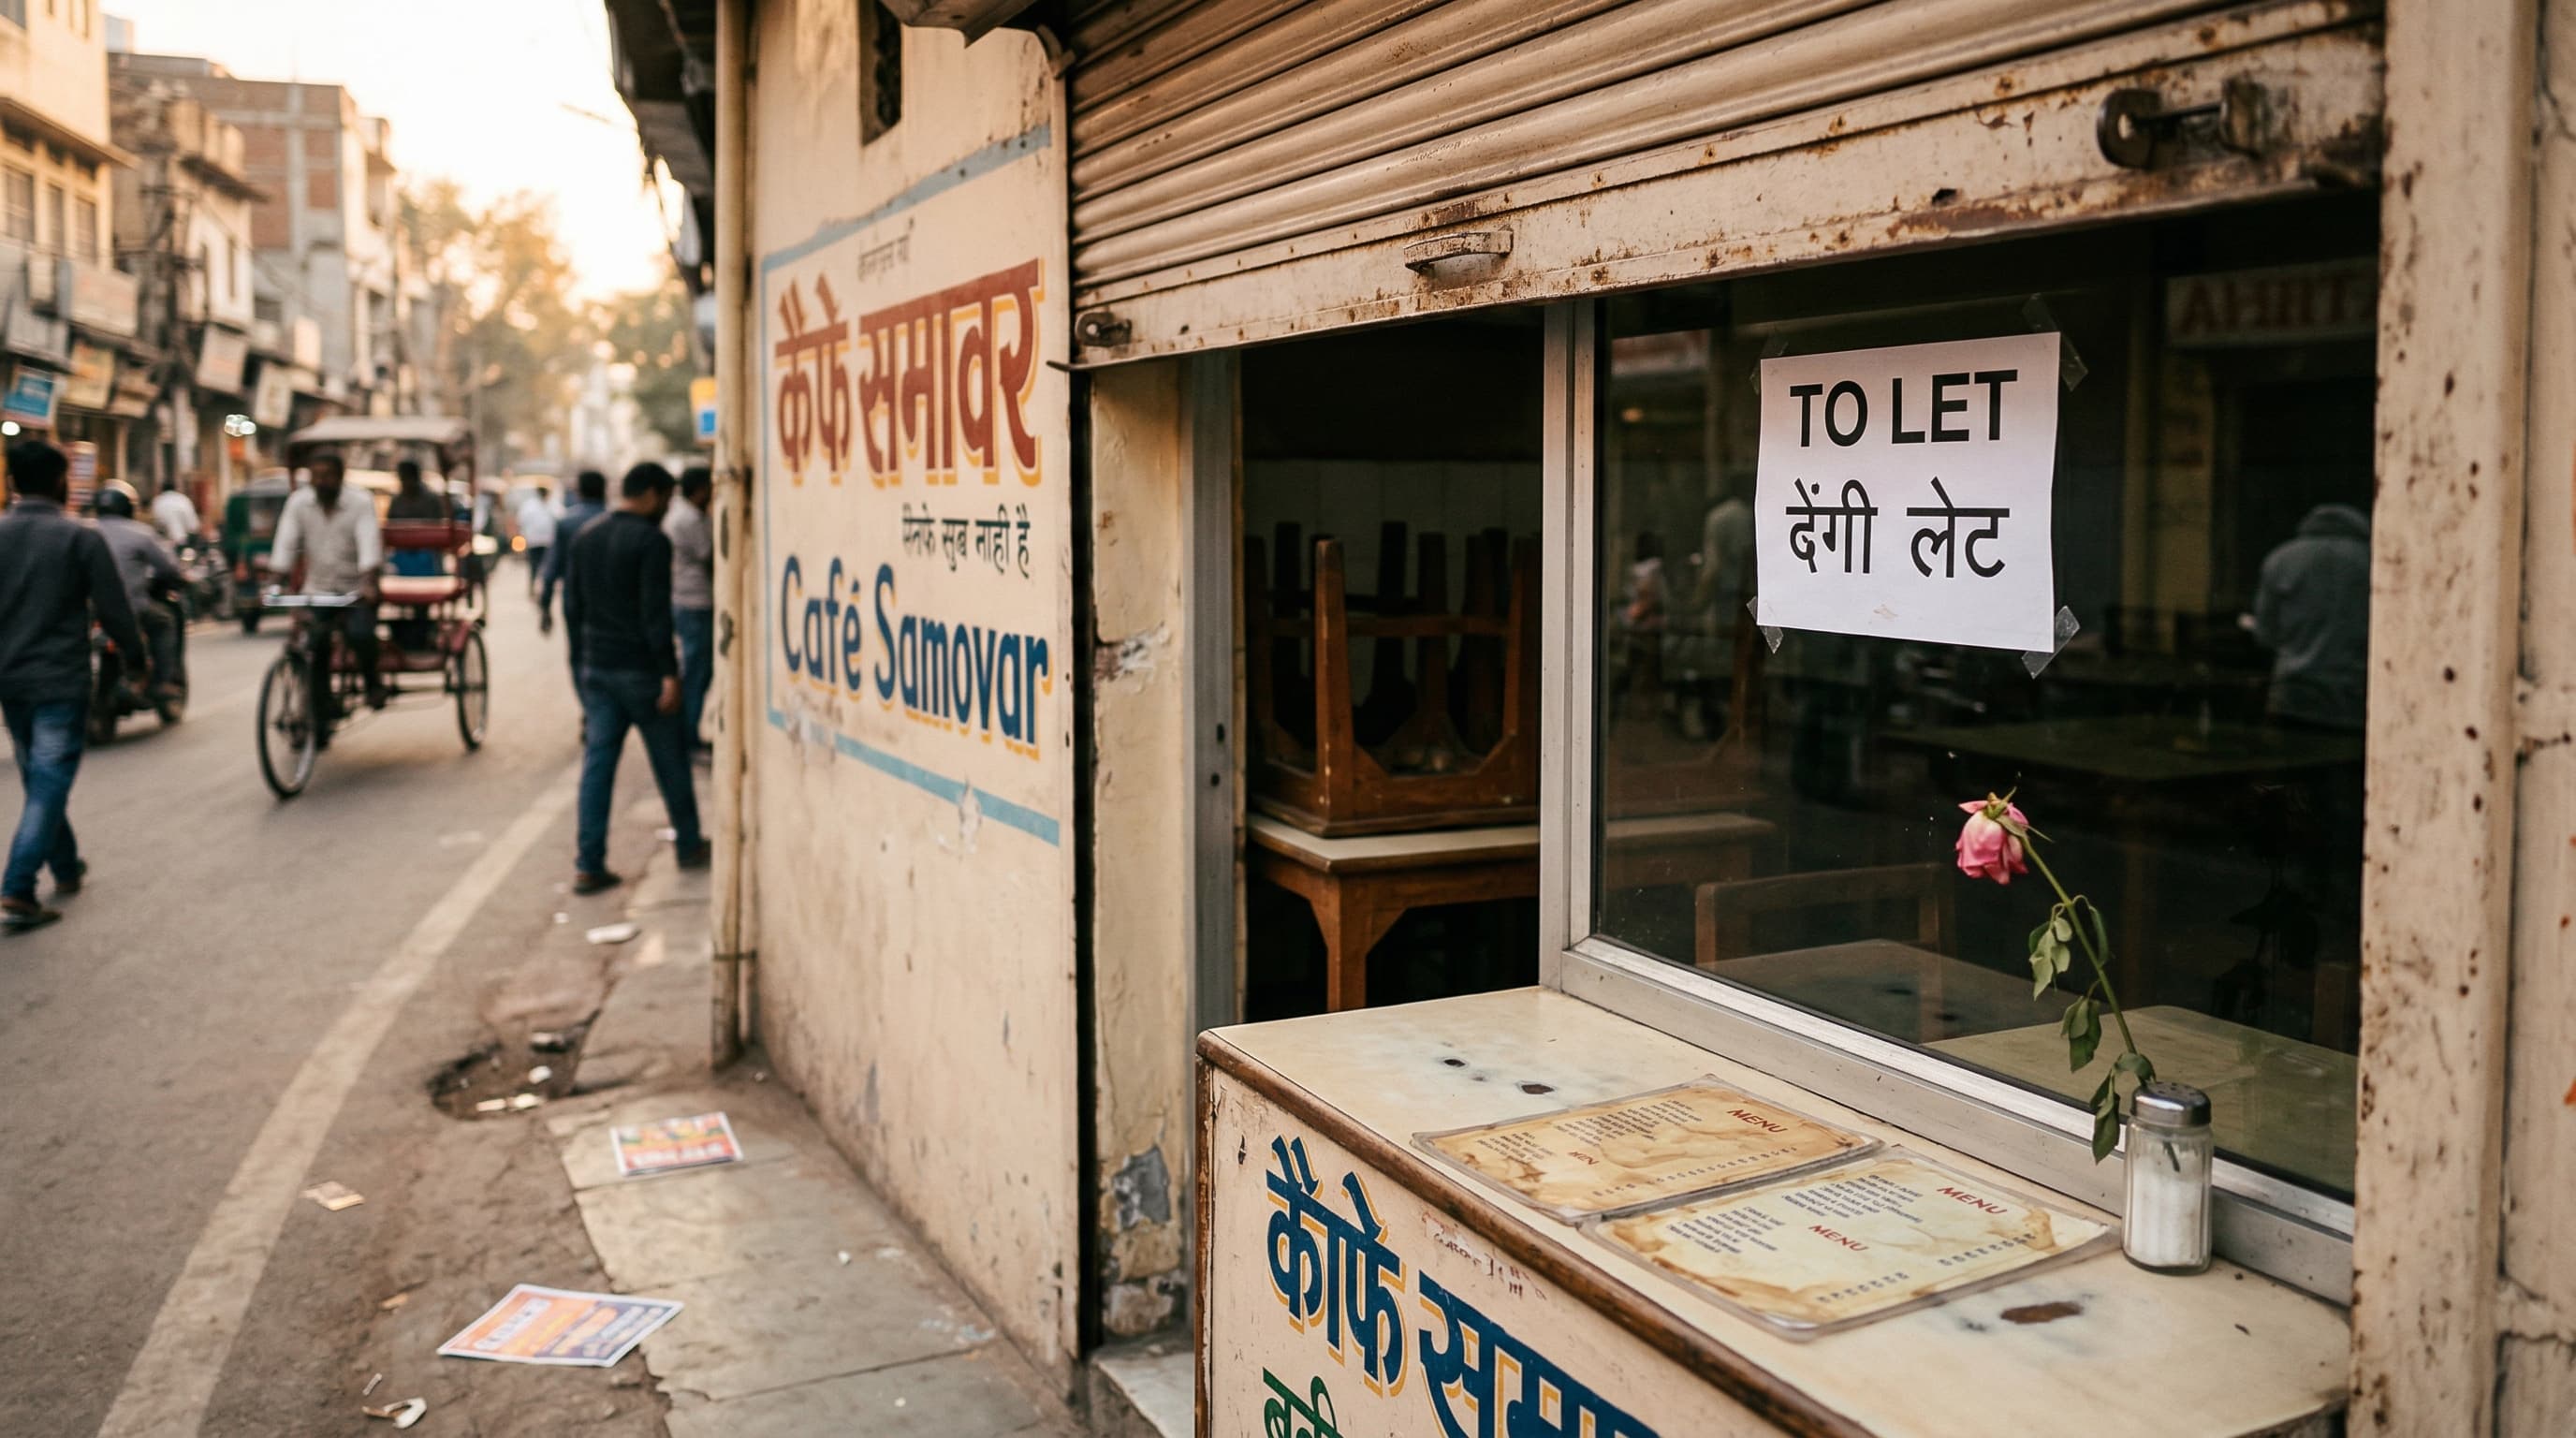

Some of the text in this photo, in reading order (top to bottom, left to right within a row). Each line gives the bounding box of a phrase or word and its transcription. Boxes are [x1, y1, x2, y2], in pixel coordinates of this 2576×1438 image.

[859, 258, 1043, 480] समावर
[1789, 369, 2018, 448] TO LET
[1785, 476, 2011, 579] देंगी लेट
[781, 555, 1050, 752] Café Samovar
[1727, 1108, 1788, 1134] MENU
[1808, 1224, 1870, 1252] MENU
[1936, 1185, 2008, 1215] MENU
